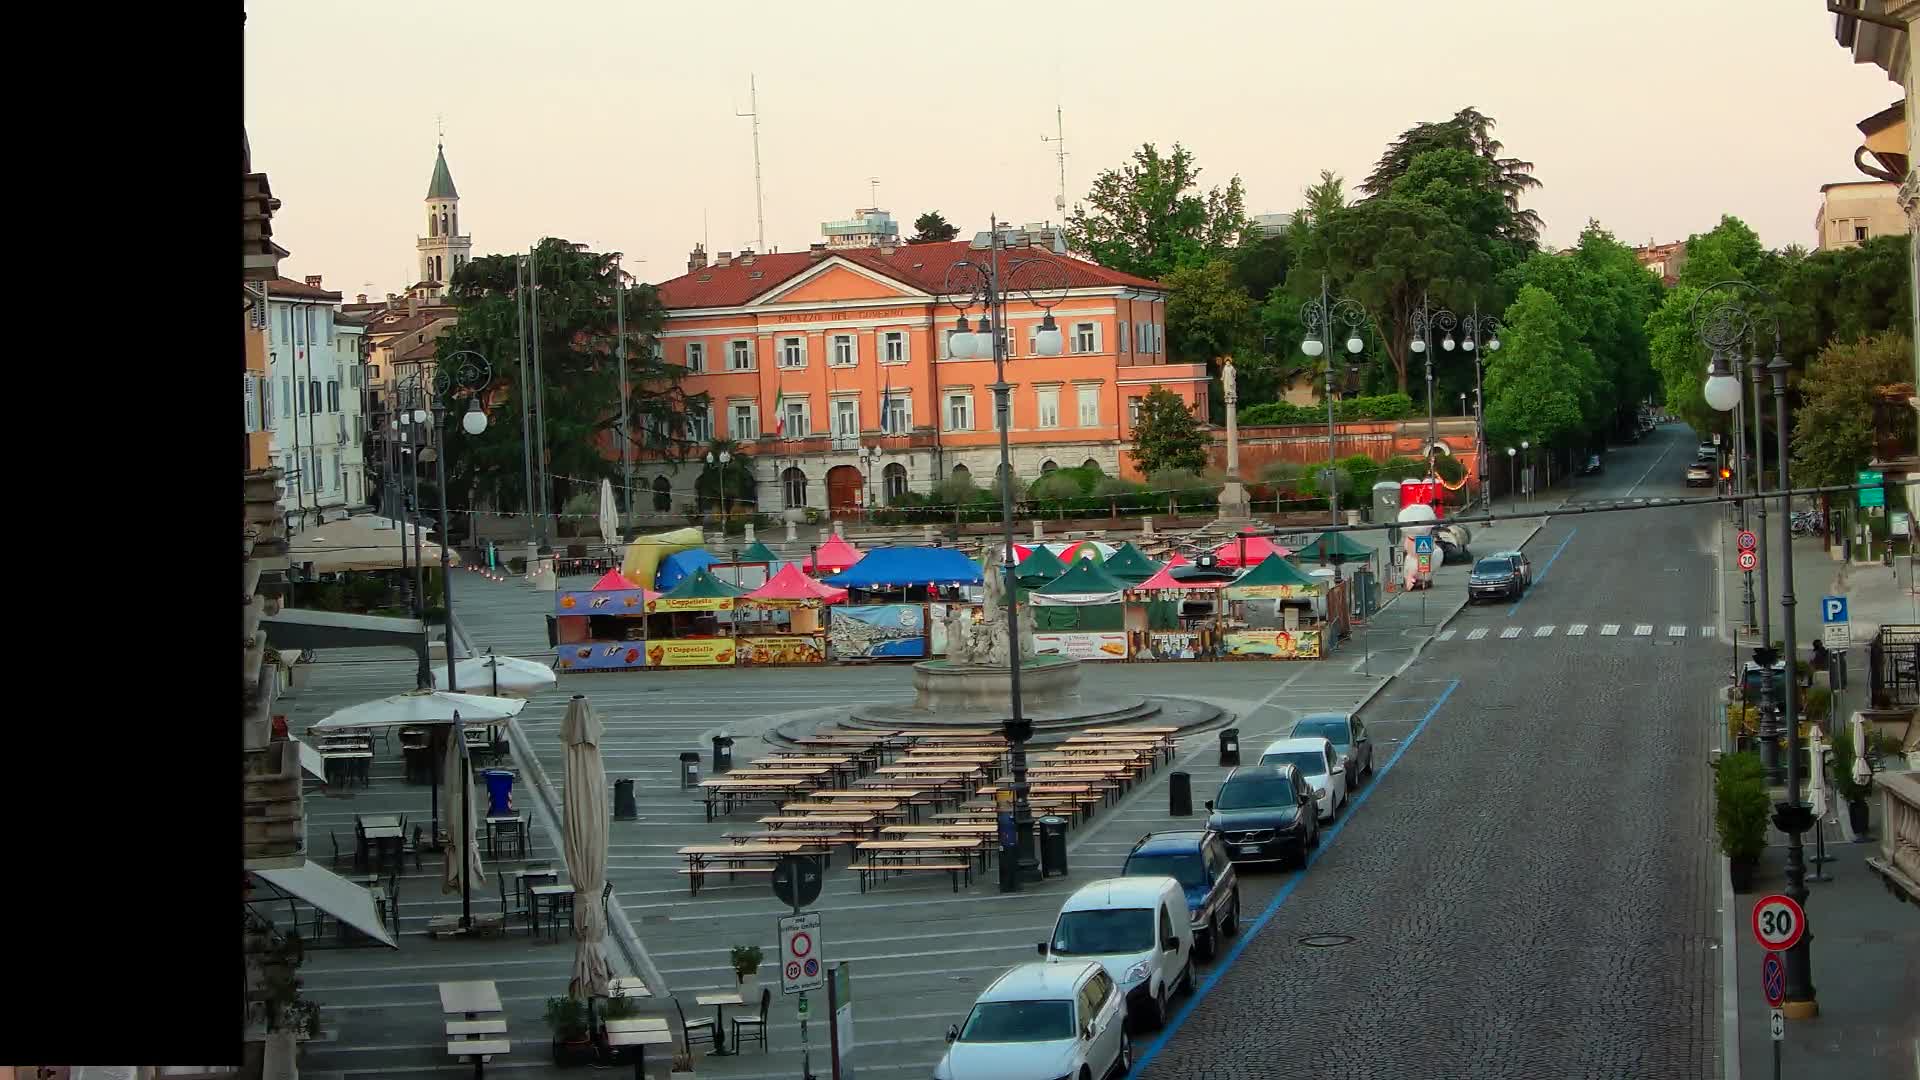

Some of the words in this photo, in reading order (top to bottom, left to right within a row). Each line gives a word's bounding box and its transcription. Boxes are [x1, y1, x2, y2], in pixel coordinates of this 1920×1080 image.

[831, 311, 848, 321] DEL
[1742, 556, 1753, 565] 20
[1827, 600, 1843, 620] P
[1762, 910, 1792, 935] 30
[789, 967, 798, 975] 20
